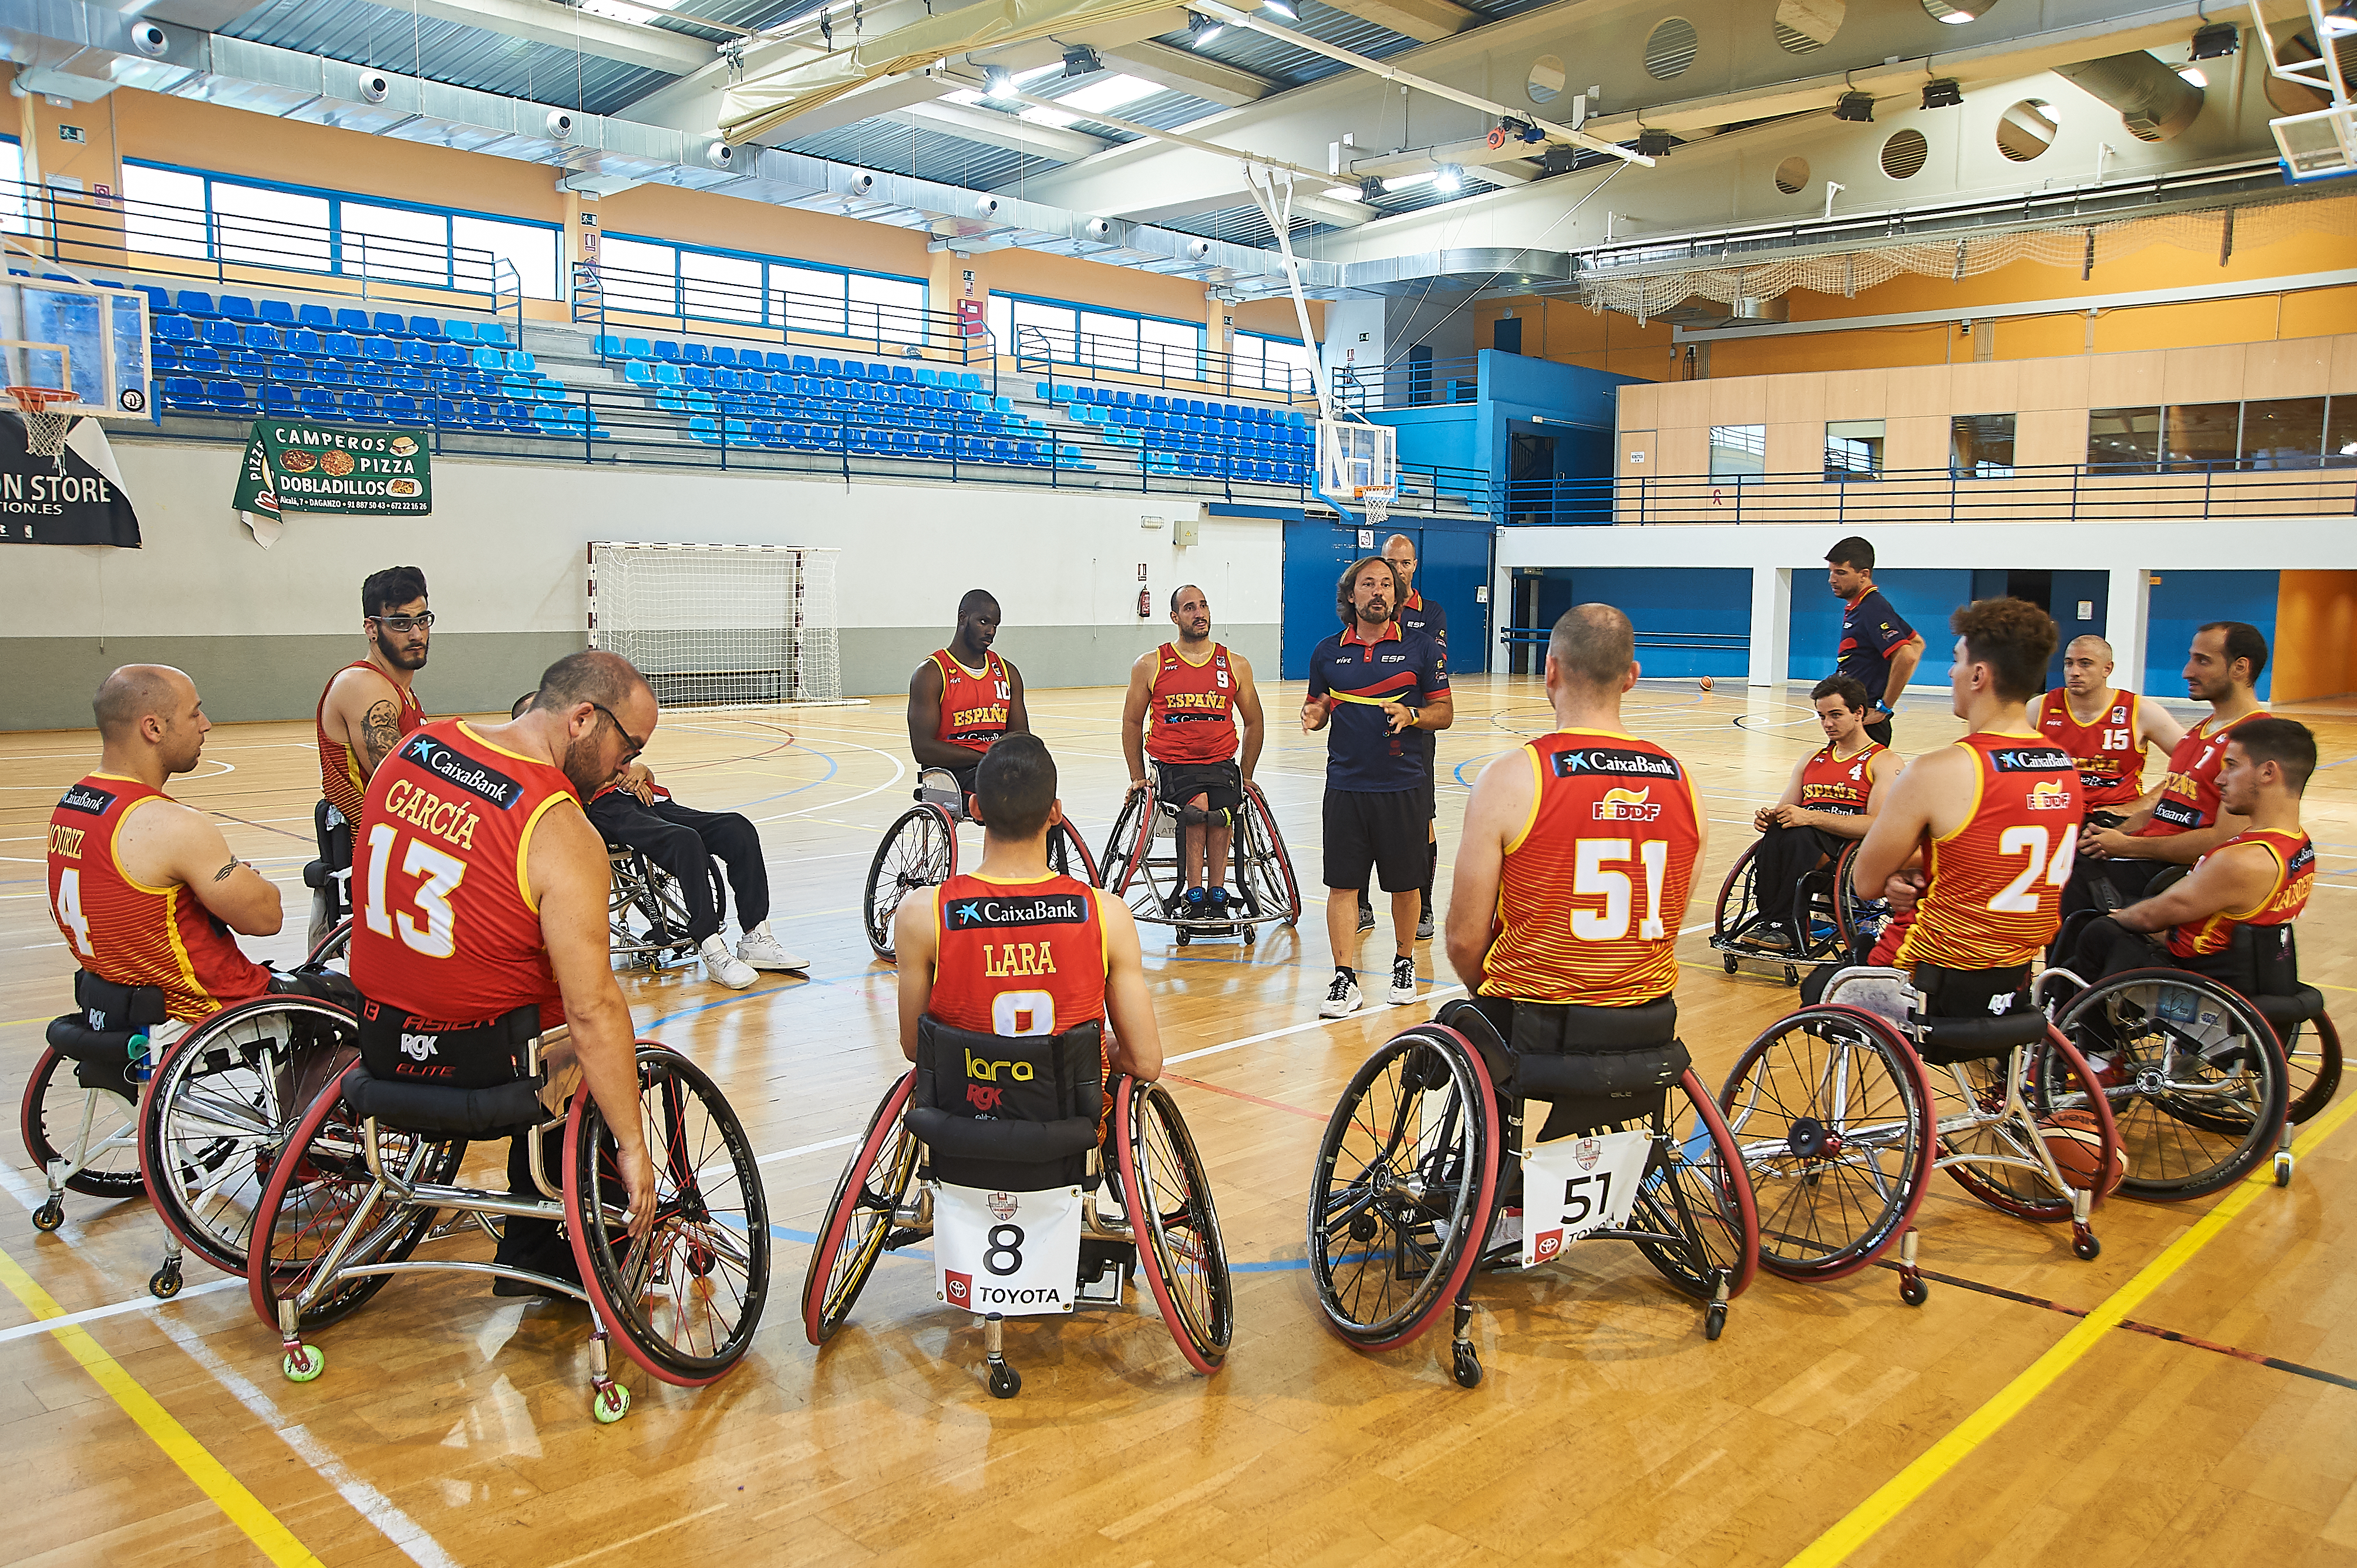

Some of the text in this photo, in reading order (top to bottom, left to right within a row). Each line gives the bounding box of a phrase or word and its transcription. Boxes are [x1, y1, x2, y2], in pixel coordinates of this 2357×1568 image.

[276, 428, 386, 451] CAMPEROS
[360, 457, 415, 474] PIZZA
[0, 473, 112, 503] N STORE
[280, 476, 386, 496] DOBLADILLOS
[309, 498, 341, 508] DAGANZO
[347, 501, 355, 509] 91
[356, 501, 368, 510] 887
[994, 680, 1011, 700] 10
[1216, 670, 1229, 689] 9
[1164, 690, 1227, 709] ESPAÑA
[2102, 728, 2130, 750] 15
[1590, 751, 1675, 775] CaixaBank
[2018, 751, 2073, 768] CaixaBank
[430, 750, 509, 802] CaixaBank
[1848, 763, 1863, 781] 4
[385, 778, 481, 851] GARCÍA
[1592, 801, 1661, 822] FEDDF
[48, 823, 86, 860] OURIZ
[1986, 823, 2078, 913] 24
[364, 822, 468, 959] 13
[1570, 838, 1669, 942] 51
[56, 866, 96, 959] 4
[984, 899, 1079, 923] CaixaBank
[983, 940, 1057, 977] LARA
[395, 1063, 457, 1077] ELITE
[965, 1047, 1034, 1082] lara
[1560, 1171, 1612, 1225] 51
[983, 1223, 1025, 1276] 8
[979, 1286, 1060, 1304] TOYOTA
